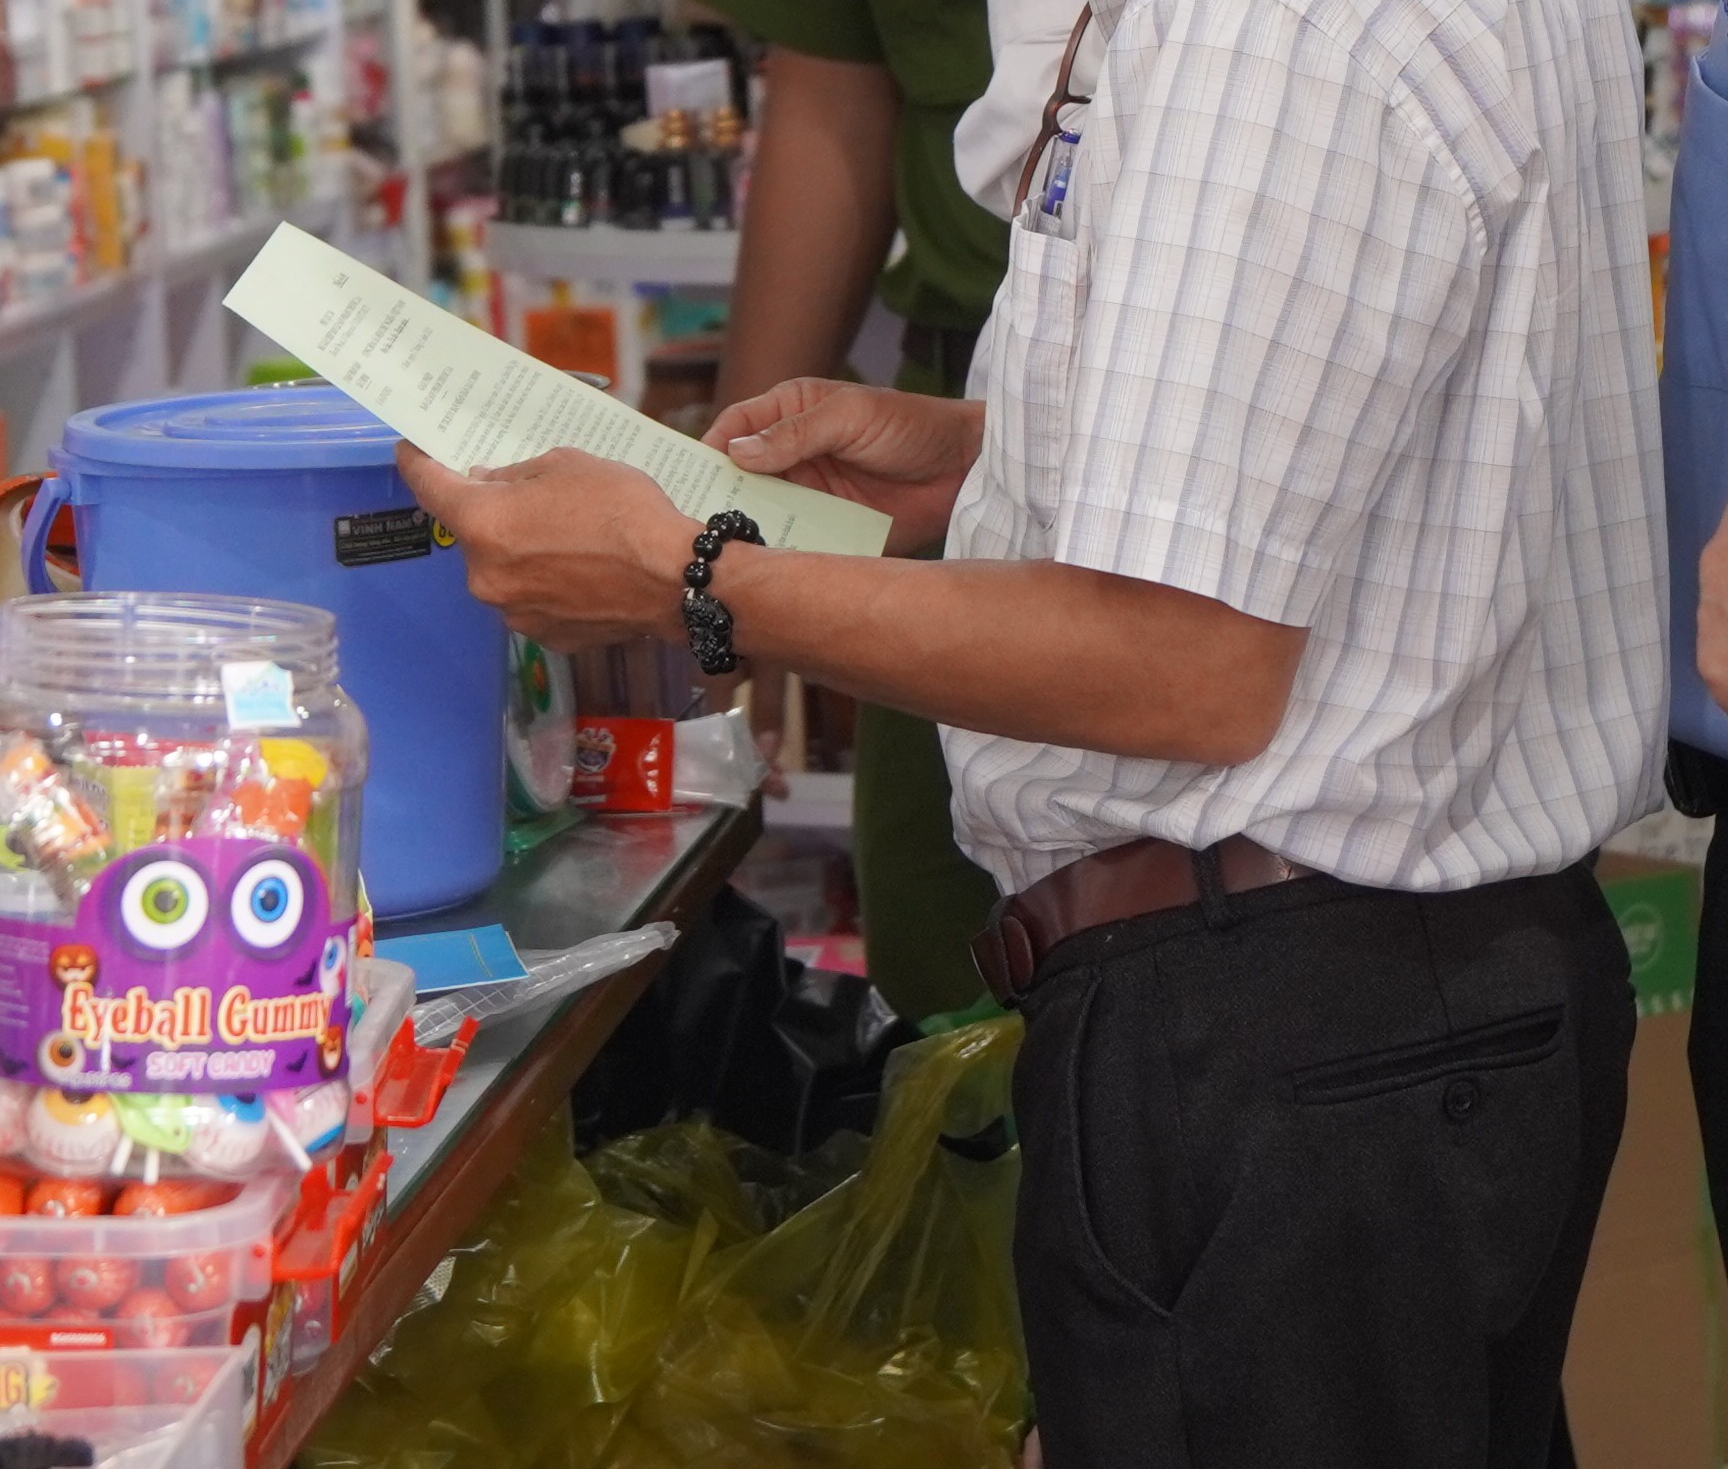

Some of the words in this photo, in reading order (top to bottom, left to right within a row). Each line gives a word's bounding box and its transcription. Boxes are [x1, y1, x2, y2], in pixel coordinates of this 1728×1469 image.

[63, 982, 212, 1049] Eyeball
[218, 985, 334, 1044] Gummy
[146, 1051, 208, 1080] SOFT
[209, 1049, 277, 1079] CANDY
